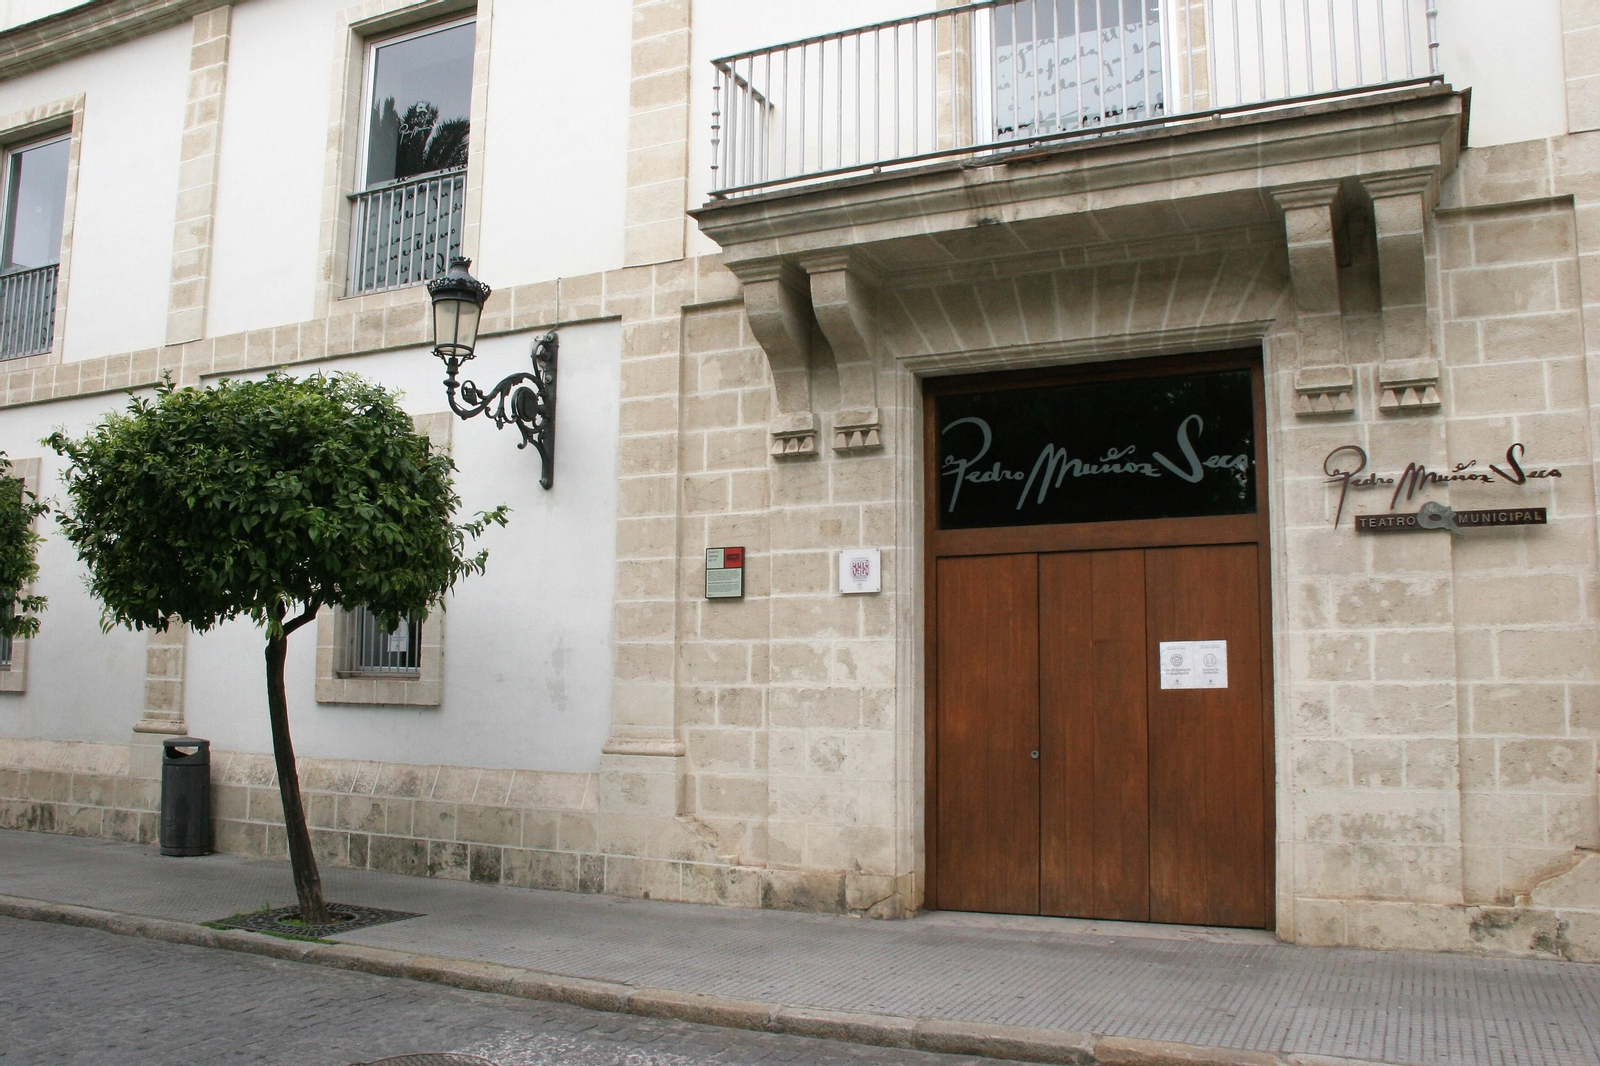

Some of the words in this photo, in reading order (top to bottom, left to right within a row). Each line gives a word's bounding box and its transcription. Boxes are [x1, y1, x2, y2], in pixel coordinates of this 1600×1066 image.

[942, 417, 1024, 512] Pedro
[1016, 443, 1161, 510] Muñoz
[1152, 414, 1248, 483] Seca
[1323, 445, 1394, 530] Pedro
[1390, 460, 1495, 510] Muñoz
[1489, 443, 1562, 485] Seca
[1359, 516, 1416, 528] TEATRO
[1458, 511, 1543, 523] MUNICIPAL
